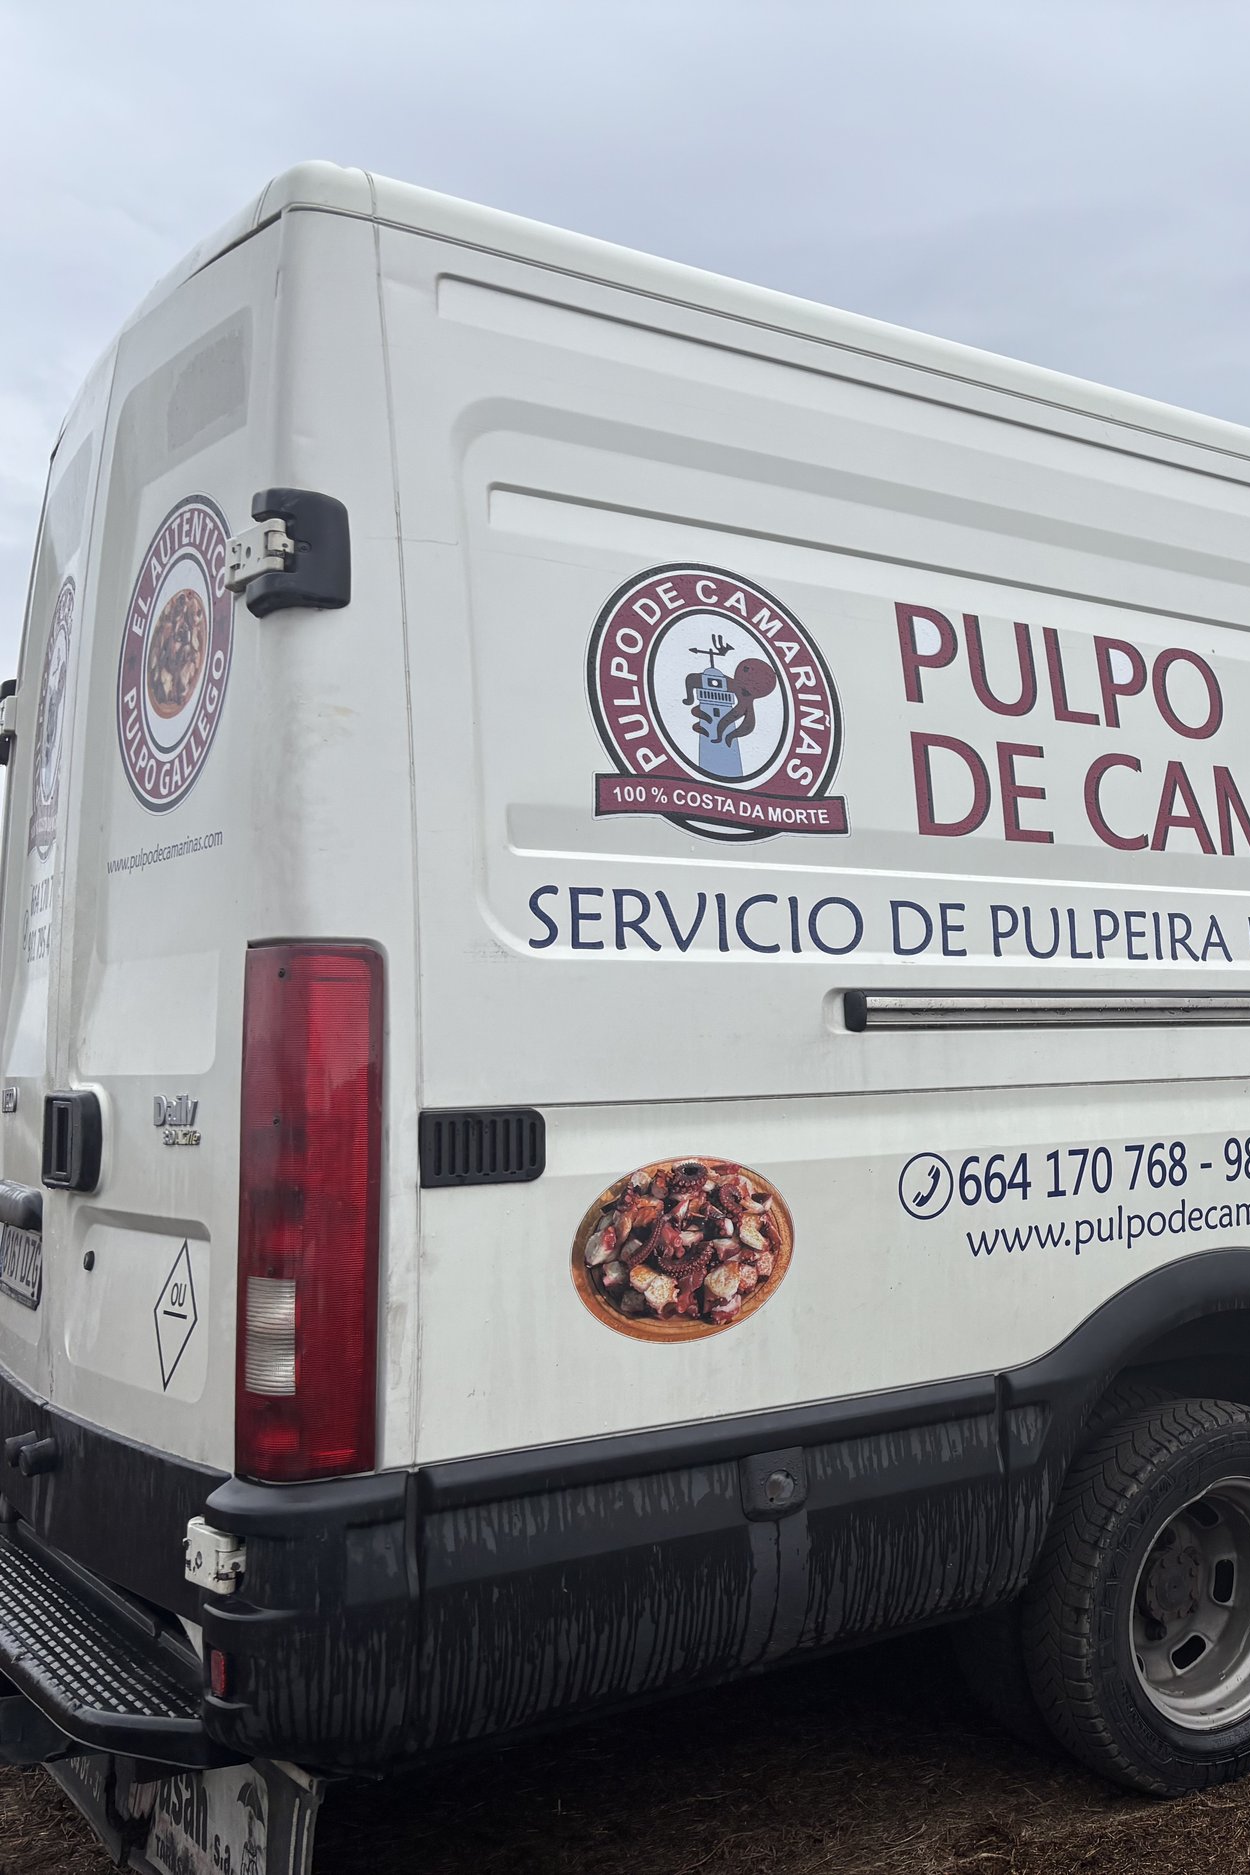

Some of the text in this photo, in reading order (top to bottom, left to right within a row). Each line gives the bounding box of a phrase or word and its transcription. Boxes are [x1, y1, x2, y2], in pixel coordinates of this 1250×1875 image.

[132, 510, 227, 637] EL AUTENTICO
[610, 580, 830, 786] PULPO DE CAMARIÑAS
[894, 601, 1224, 740] PULPO
[124, 686, 157, 791] PULPO
[160, 649, 225, 796] GALLEGO
[613, 786, 646, 803] 100
[673, 790, 735, 815] COSTA
[739, 799, 764, 820] DA
[768, 806, 829, 825] MORTE
[910, 731, 1055, 844] DE
[107, 829, 223, 876] www.pulpodecamarinas.com
[528, 884, 864, 955] SERVICIO
[889, 900, 967, 956] DE
[990, 904, 1233, 962] PULPEIRA
[958, 1151, 1032, 1206] 664
[1046, 1146, 1113, 1198] 170
[1124, 1140, 1188, 1191] 768
[1200, 1160, 1213, 1170] -
[170, 1282, 187, 1307] OU
